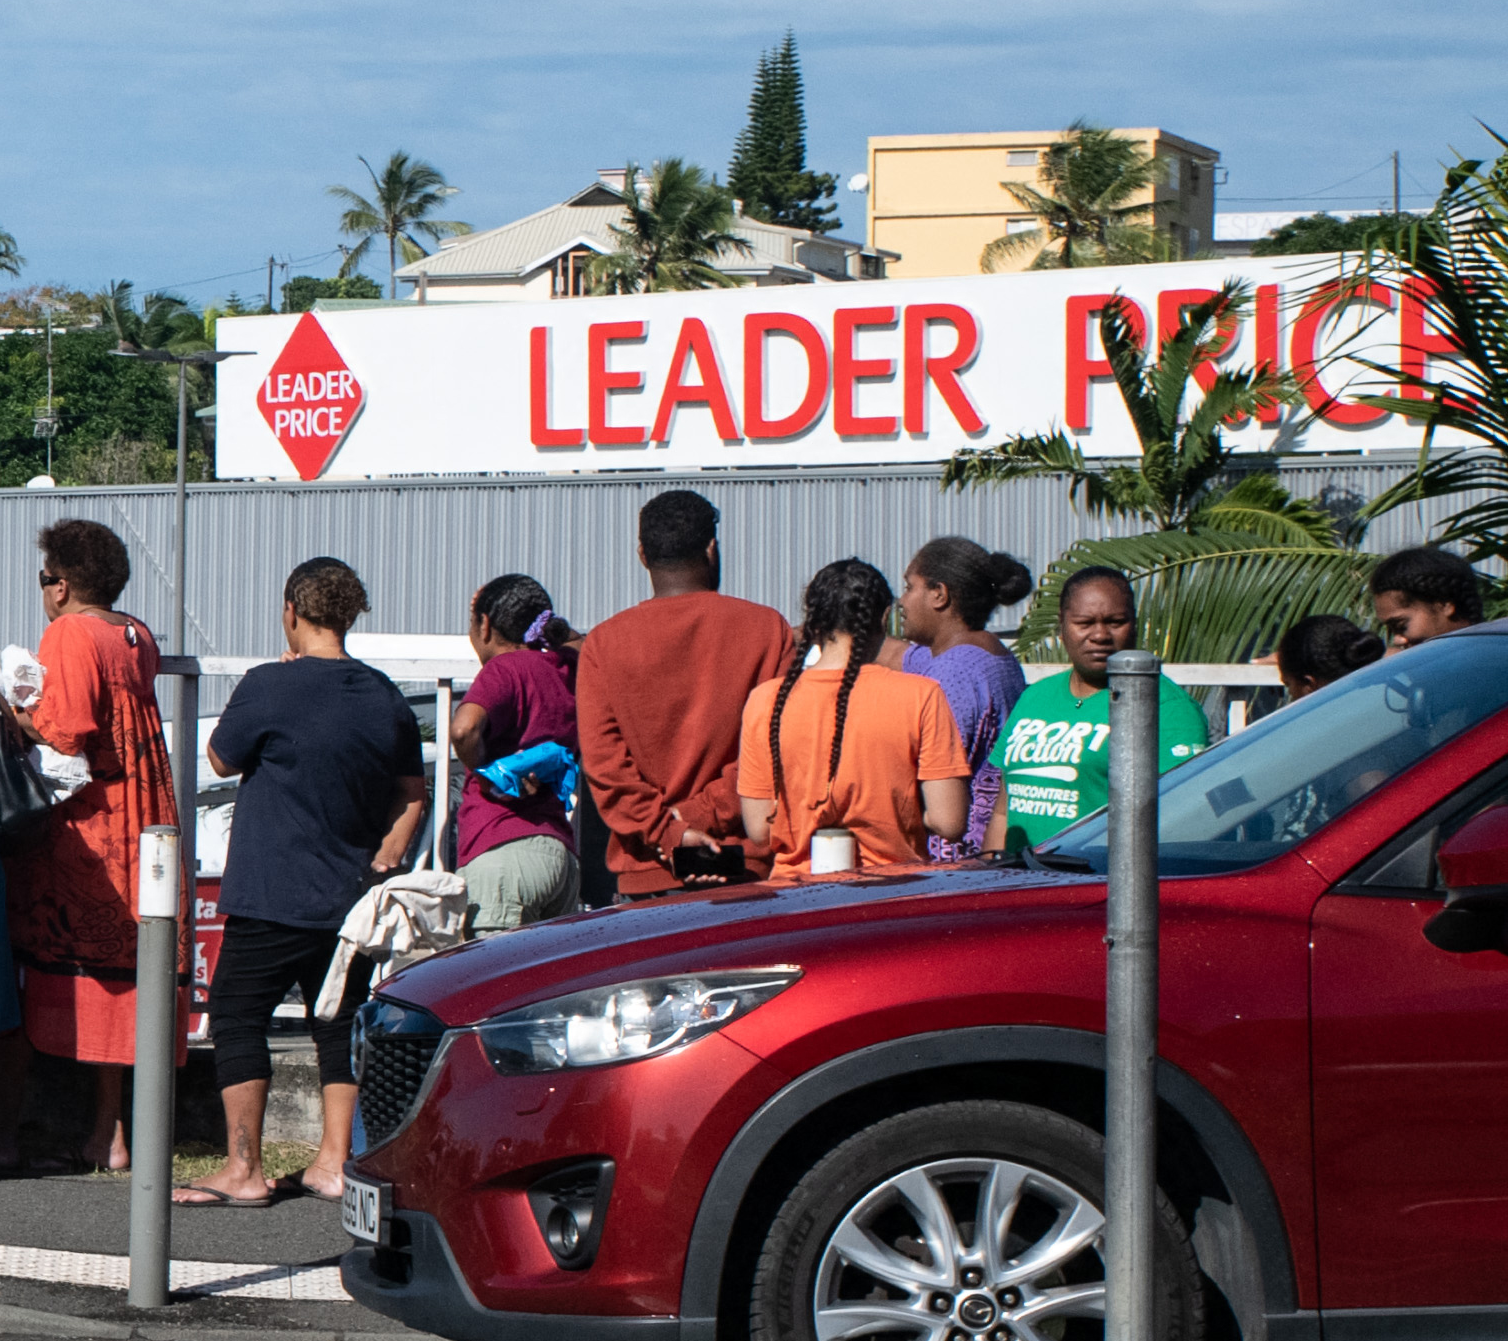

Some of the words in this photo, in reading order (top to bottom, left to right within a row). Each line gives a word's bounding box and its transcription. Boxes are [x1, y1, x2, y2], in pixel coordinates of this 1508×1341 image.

[264, 368, 356, 404] LEADER
[529, 303, 987, 447] LEADER
[274, 406, 344, 439] PRICE
[1004, 735, 1082, 767] fiction
[1007, 718, 1111, 752] SPORT
[1007, 782, 1080, 802] RENCONTRES
[359, 1189, 375, 1234] NC
